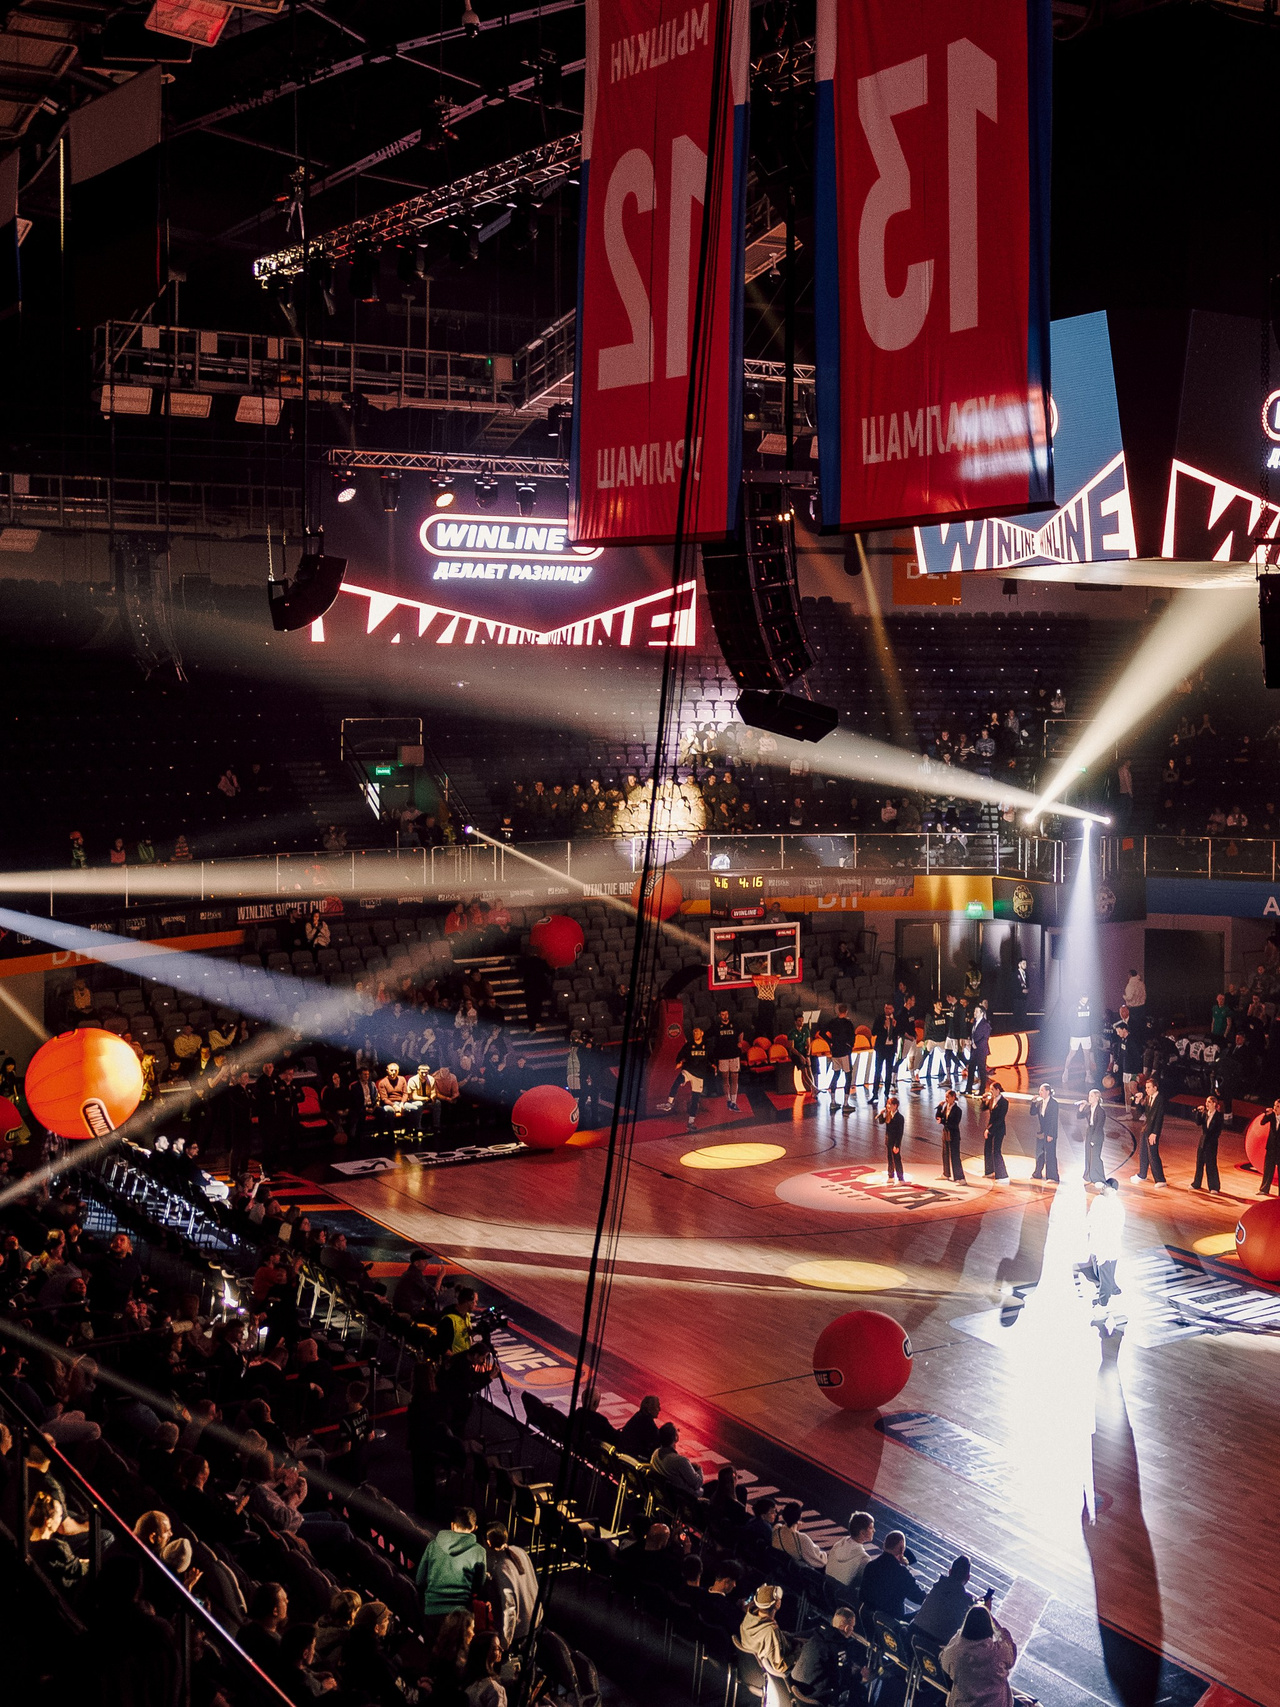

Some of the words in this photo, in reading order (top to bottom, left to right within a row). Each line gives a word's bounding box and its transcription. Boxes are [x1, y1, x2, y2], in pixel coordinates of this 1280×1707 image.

[437, 522, 566, 552] WINLINE
[433, 561, 508, 581] ДЕЛАЕТ
[508, 563, 593, 584] РАЗНИЦУ
[583, 883, 614, 898] WINLINE
[739, 876, 764, 889] 4:16
[237, 904, 274, 921] WINLINE
